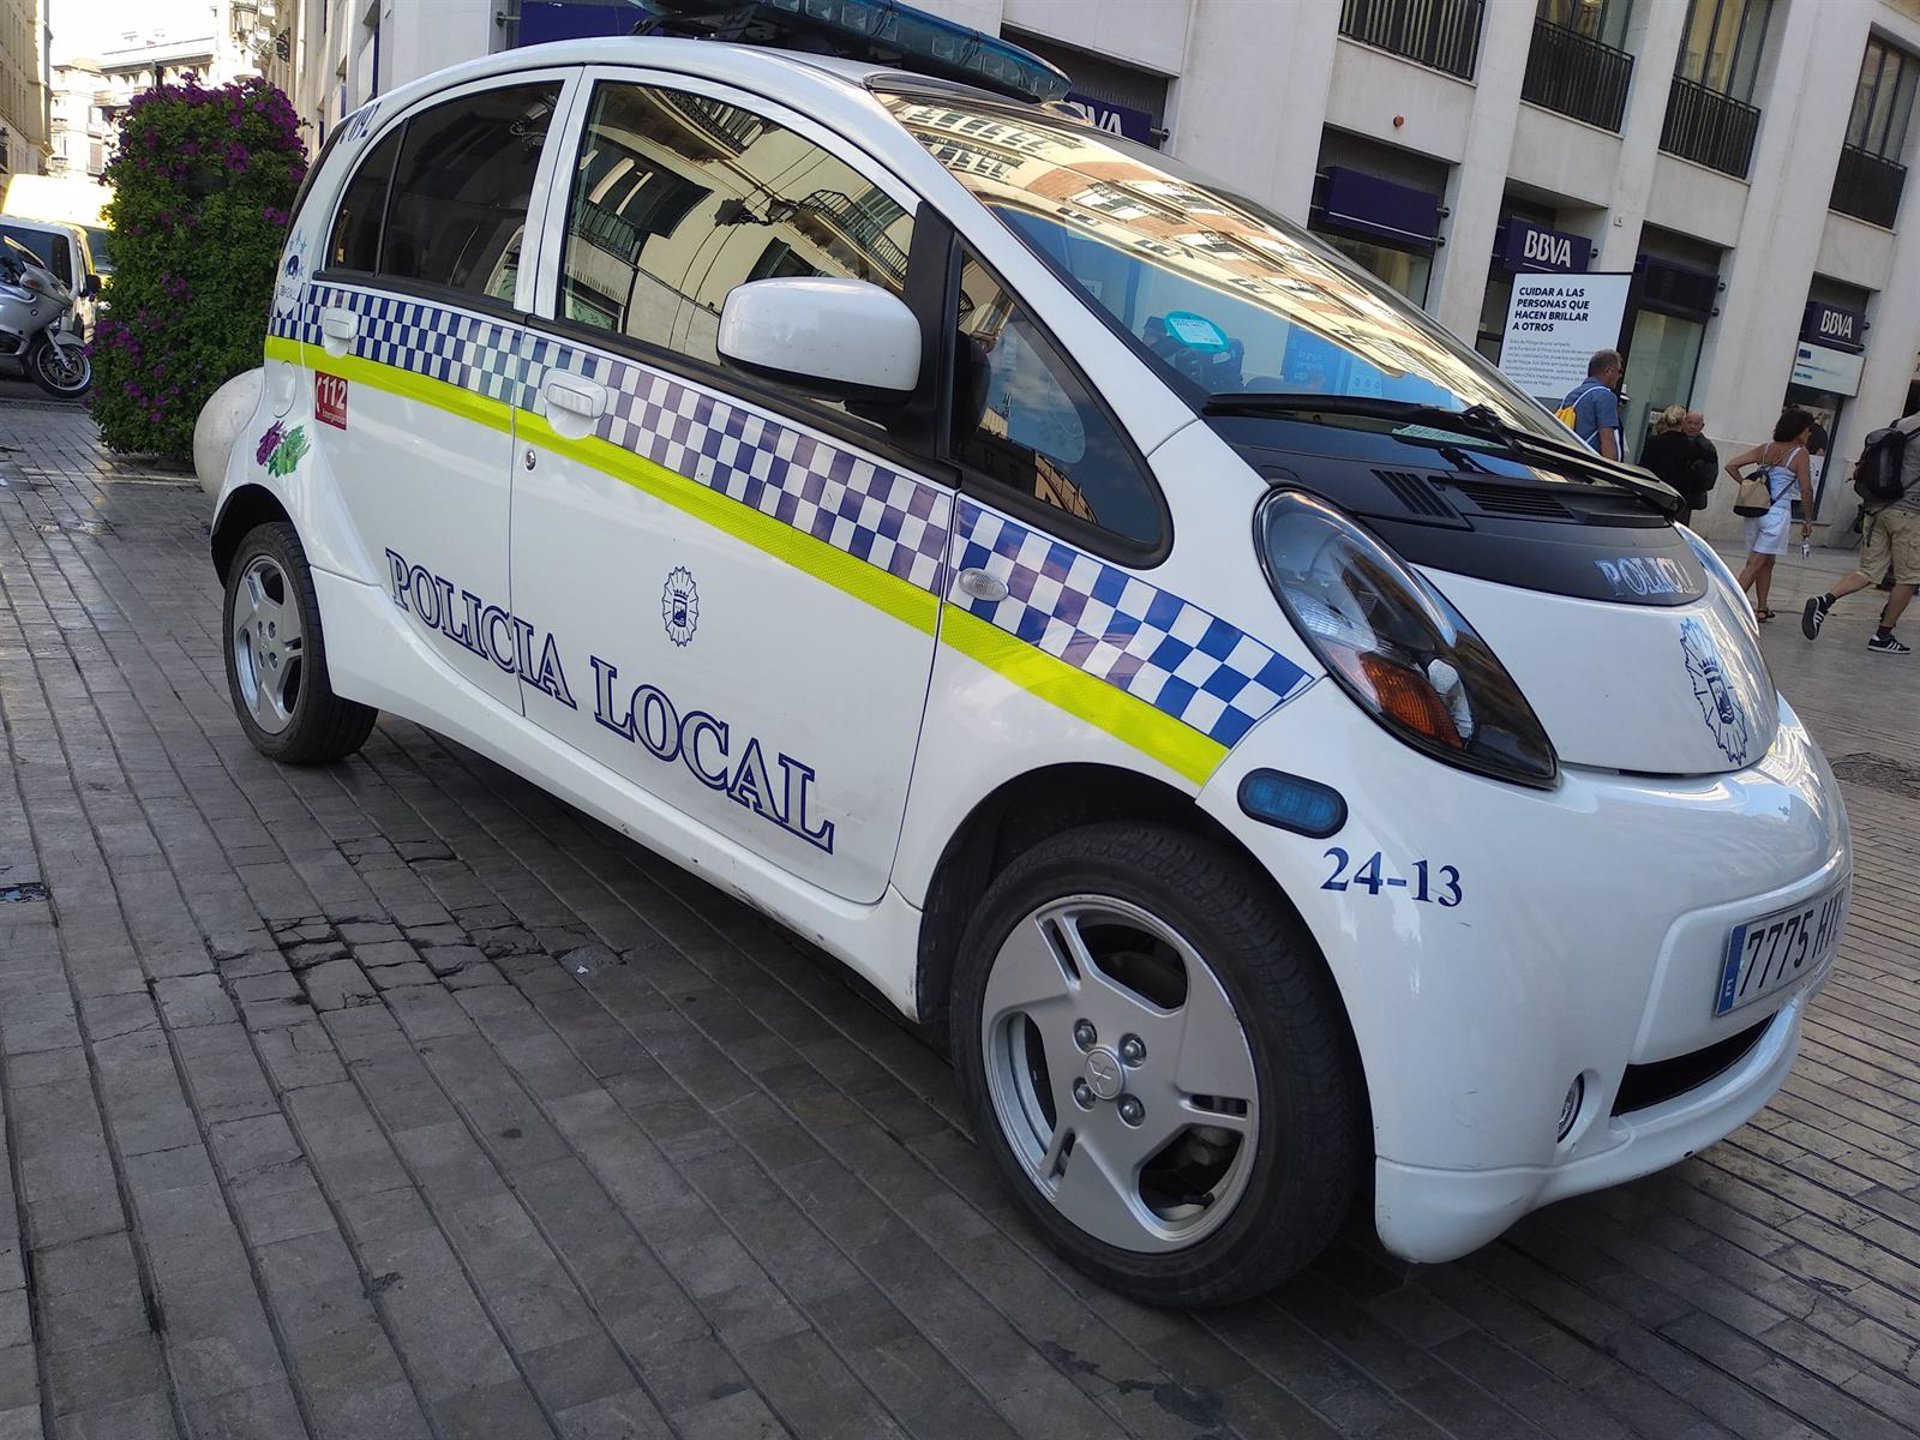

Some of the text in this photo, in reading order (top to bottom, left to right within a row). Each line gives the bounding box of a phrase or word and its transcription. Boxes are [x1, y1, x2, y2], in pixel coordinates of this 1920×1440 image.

[1523, 229, 1572, 268] BBVA
[1517, 299, 1590, 311] PERSONAS QUE
[1519, 287, 1585, 298] CUIDAR A LAS
[1512, 322, 1554, 332] A OTROS
[1514, 311, 1589, 322] HACEN BRILLAR
[1820, 310, 1853, 339] BBVA
[323, 376, 346, 410] 112
[385, 547, 835, 854] POLICIA LOCAL
[1320, 847, 1463, 907] 24-13
[1738, 909, 1814, 997] 7775
